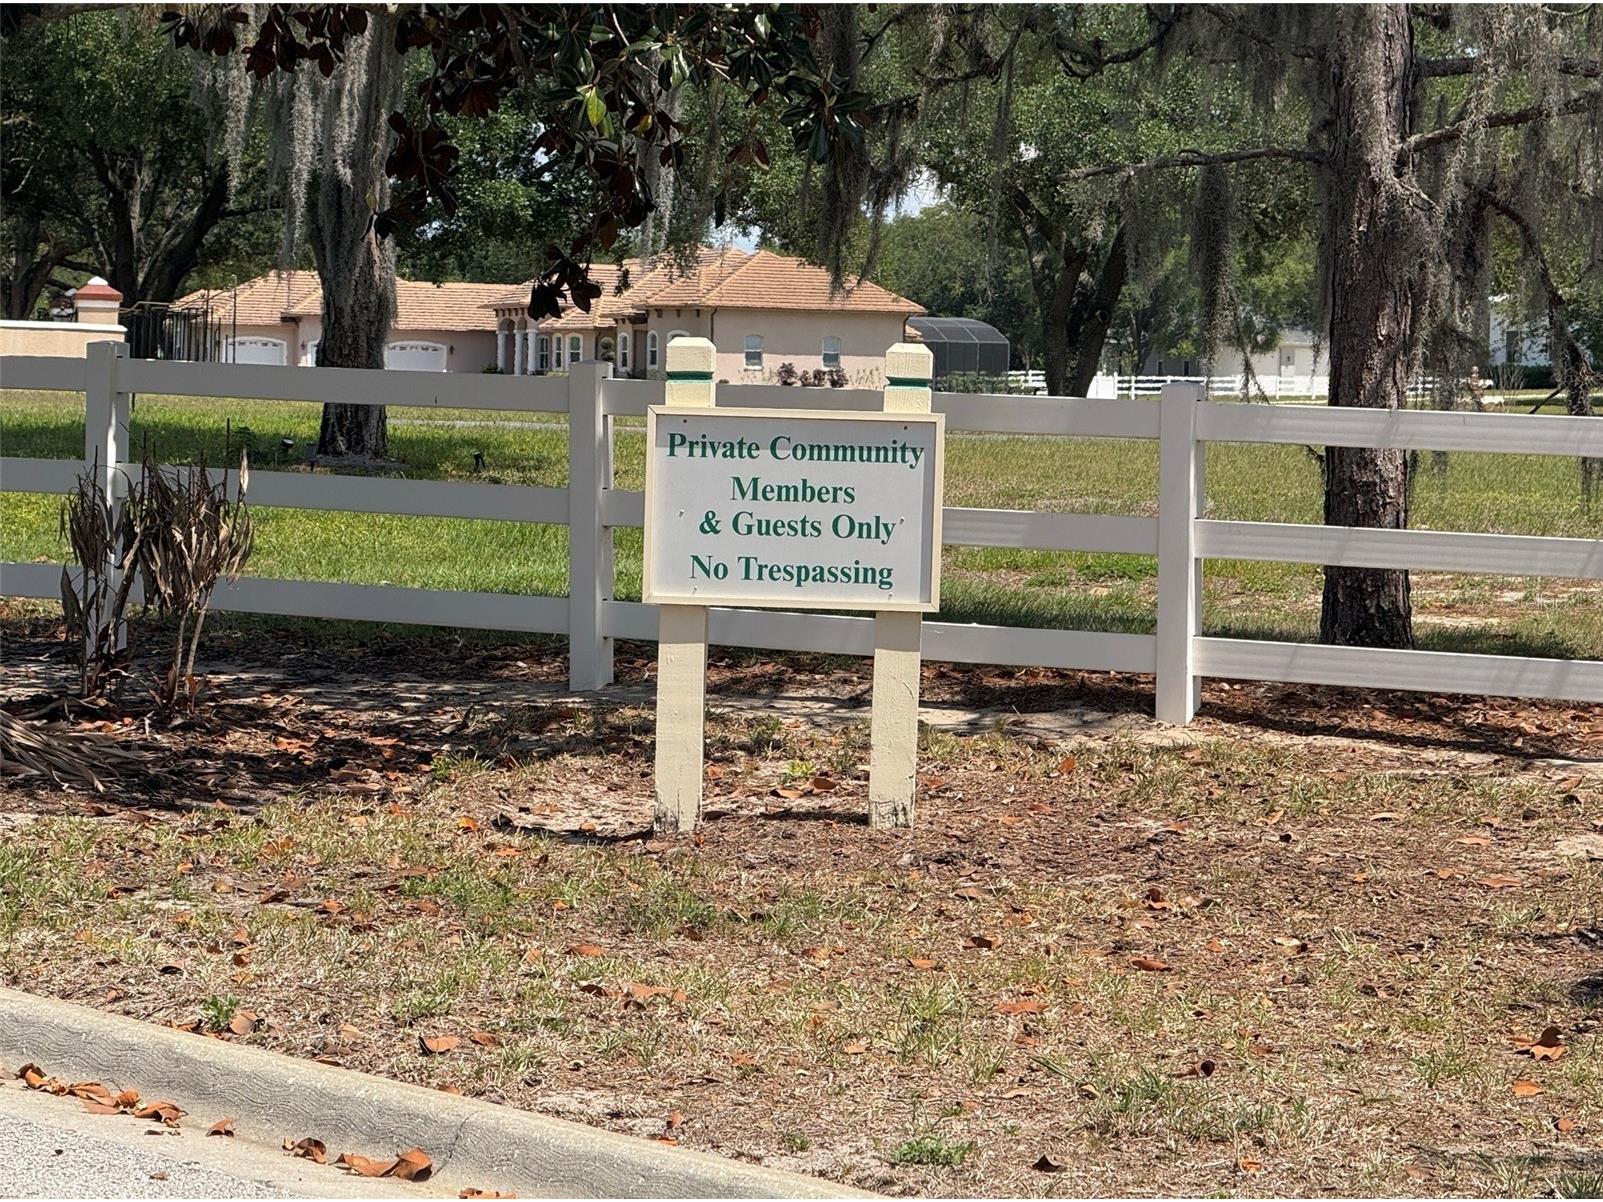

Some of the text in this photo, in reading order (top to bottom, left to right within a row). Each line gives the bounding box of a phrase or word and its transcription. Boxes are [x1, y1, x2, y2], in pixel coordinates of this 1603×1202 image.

[667, 432, 925, 469] Private Community
[730, 476, 855, 504] Members
[699, 510, 896, 545] & Guests Only
[689, 554, 893, 590] No Trespassing
